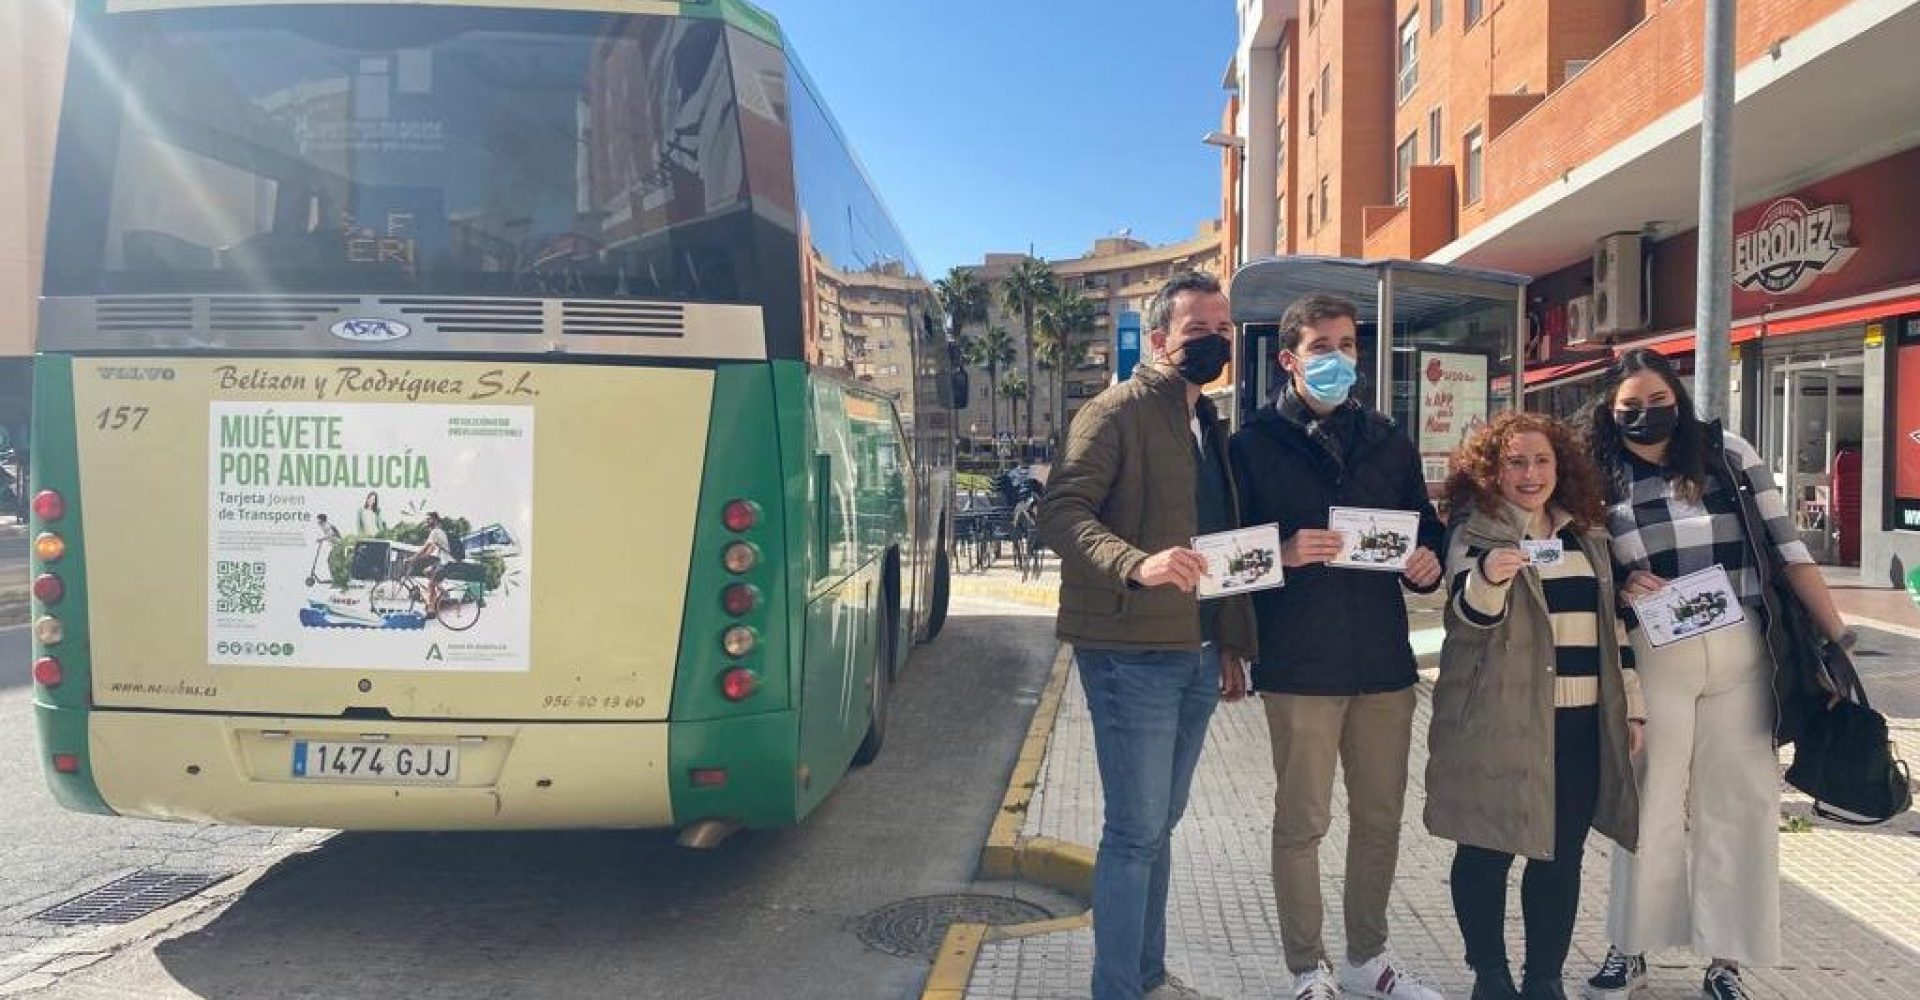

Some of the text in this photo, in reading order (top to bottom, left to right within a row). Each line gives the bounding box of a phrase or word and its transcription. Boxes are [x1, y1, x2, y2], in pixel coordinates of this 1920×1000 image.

[1735, 208, 1832, 272] EURODIEZ
[216, 365, 305, 390] Belizon
[315, 375, 329, 399] y
[470, 369, 541, 400] S.L.
[97, 405, 150, 431] 157
[220, 408, 344, 450] MUÉVETE
[220, 446, 432, 489] POR ANDALUCÍA
[220, 491, 265, 507] Tarjeta
[219, 508, 311, 524] de Transporte
[111, 680, 217, 698] www.nbus.es
[318, 744, 451, 777] 1474 GJJ
